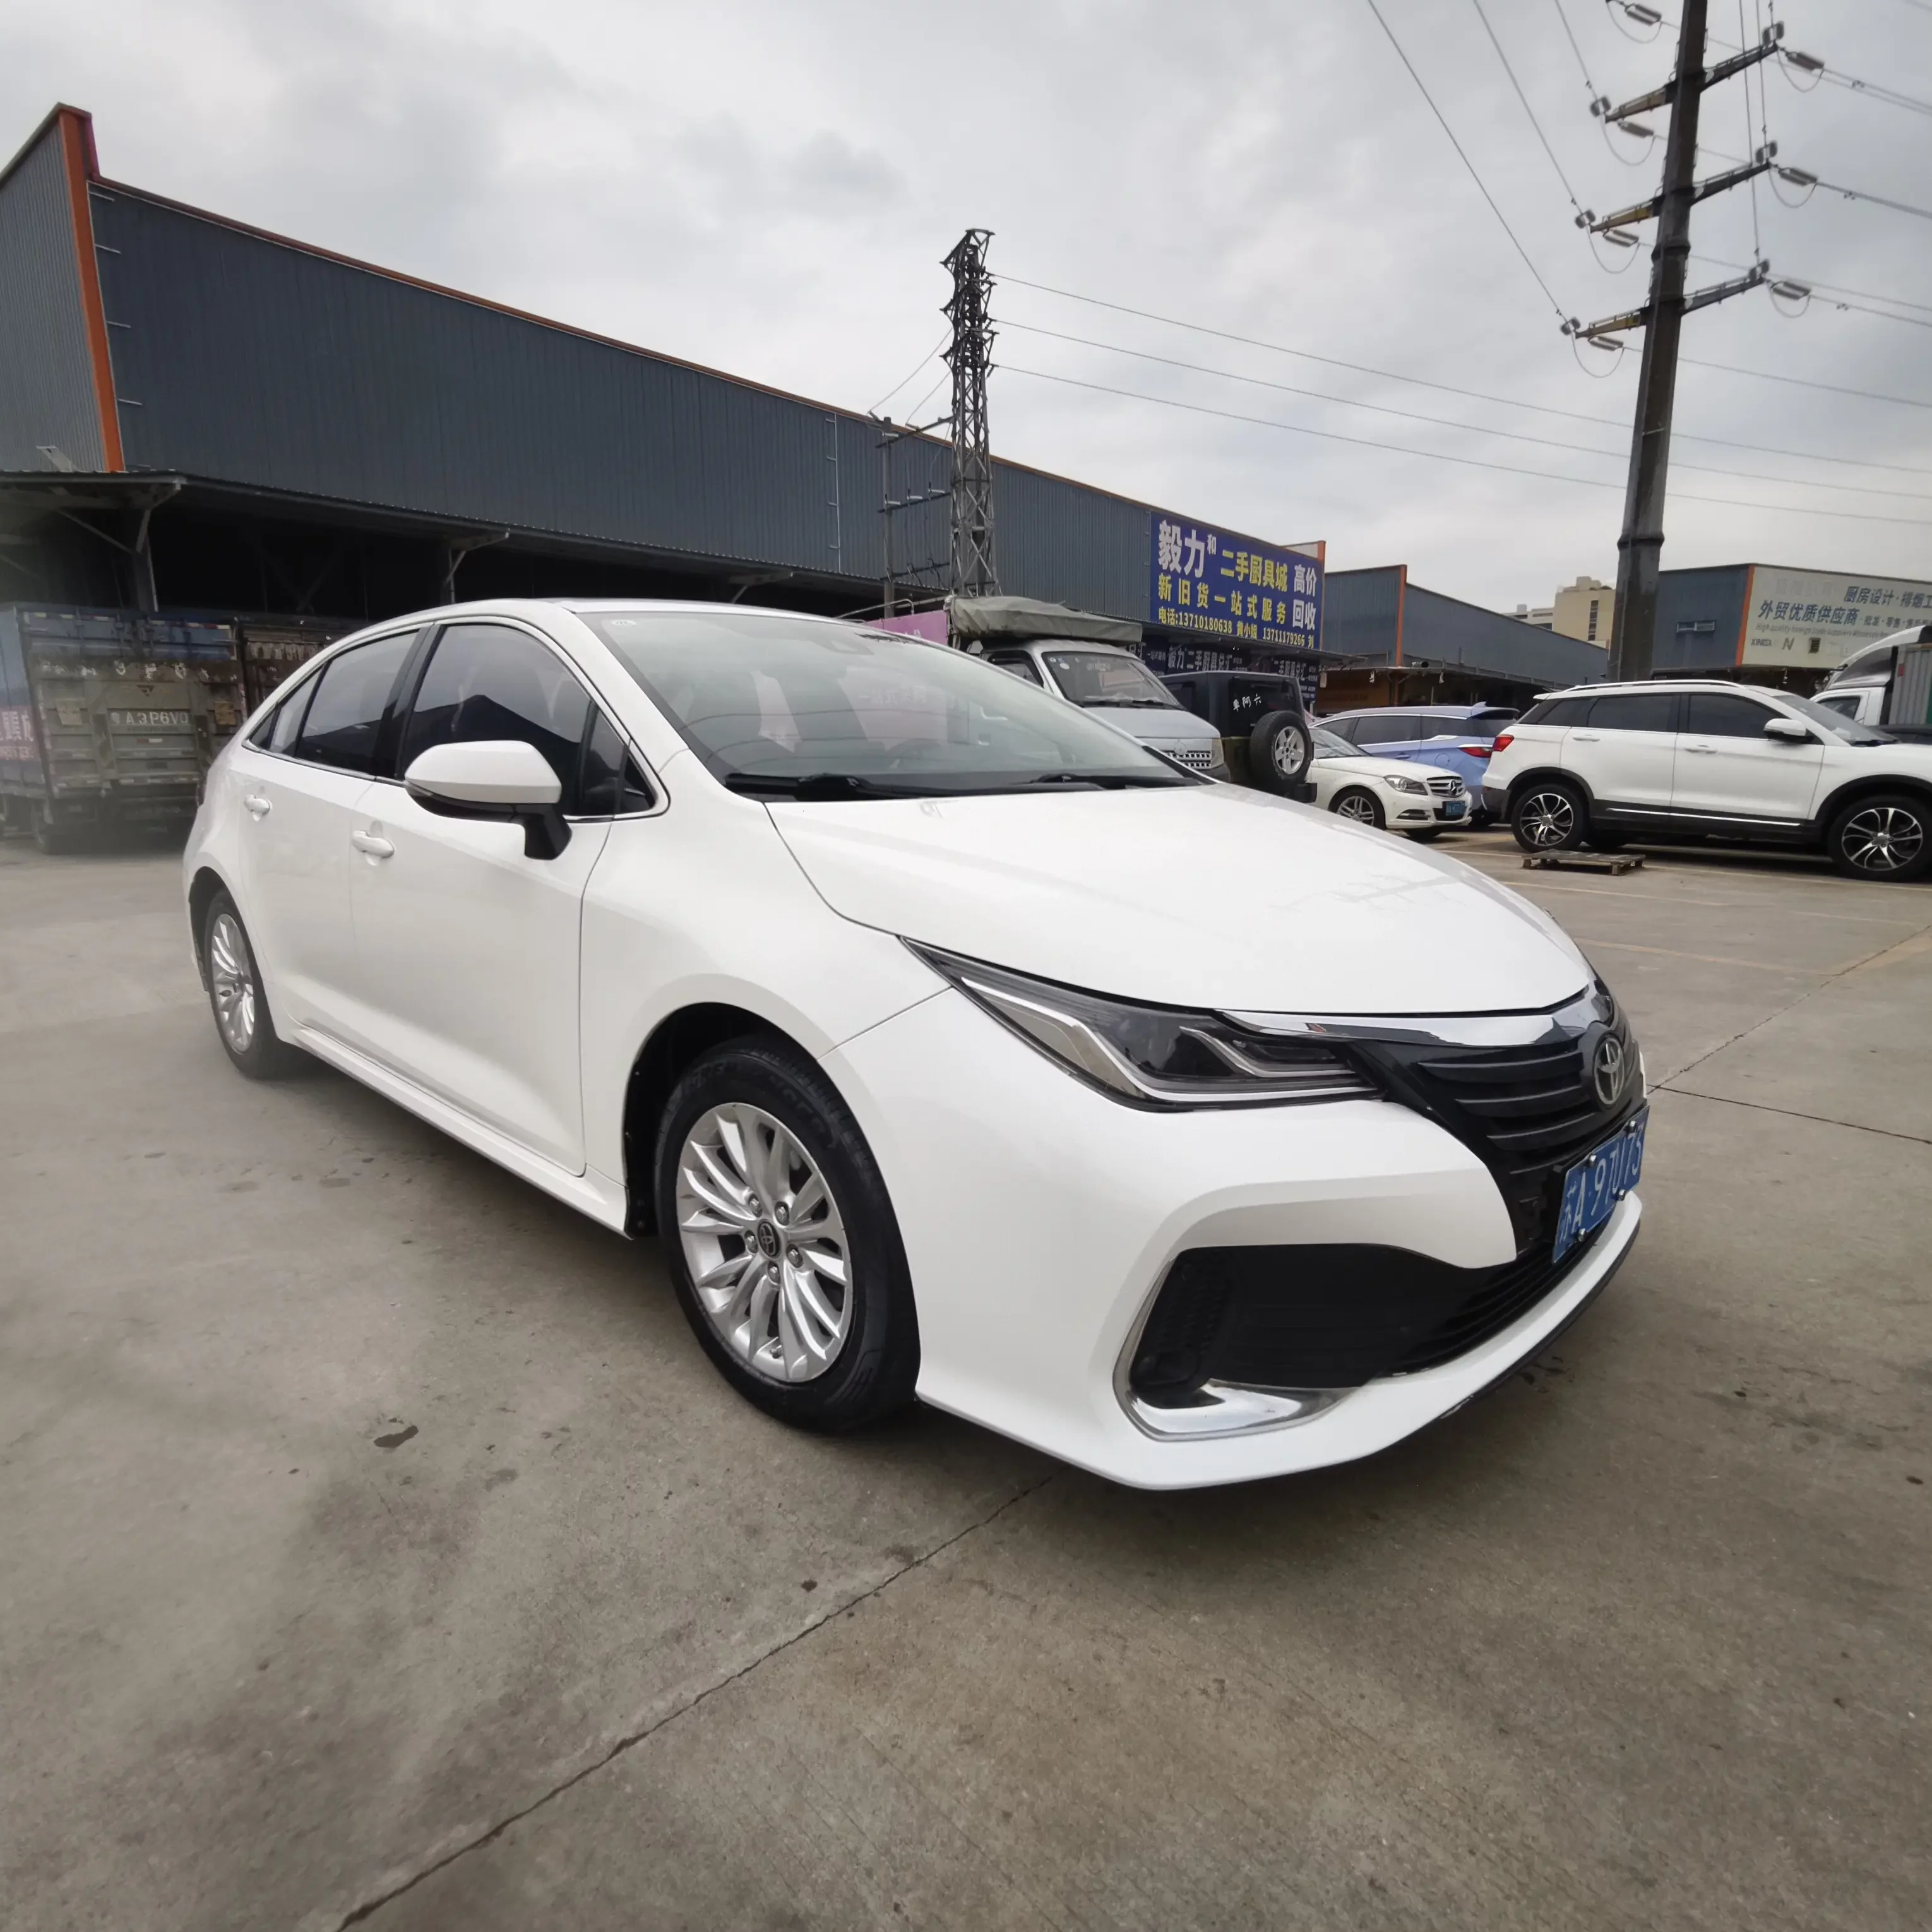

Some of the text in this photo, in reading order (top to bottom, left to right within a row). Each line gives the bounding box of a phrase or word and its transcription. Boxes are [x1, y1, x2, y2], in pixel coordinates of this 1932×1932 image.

[1158, 520, 1205, 578] 毅力
[1221, 549, 1288, 592] 二手厨具城
[1294, 563, 1317, 597] 高价
[1158, 573, 1286, 624] 新旧货一站式服务
[1292, 599, 1316, 631] 回收
[1757, 599, 1860, 626] 外贸优质供应商
